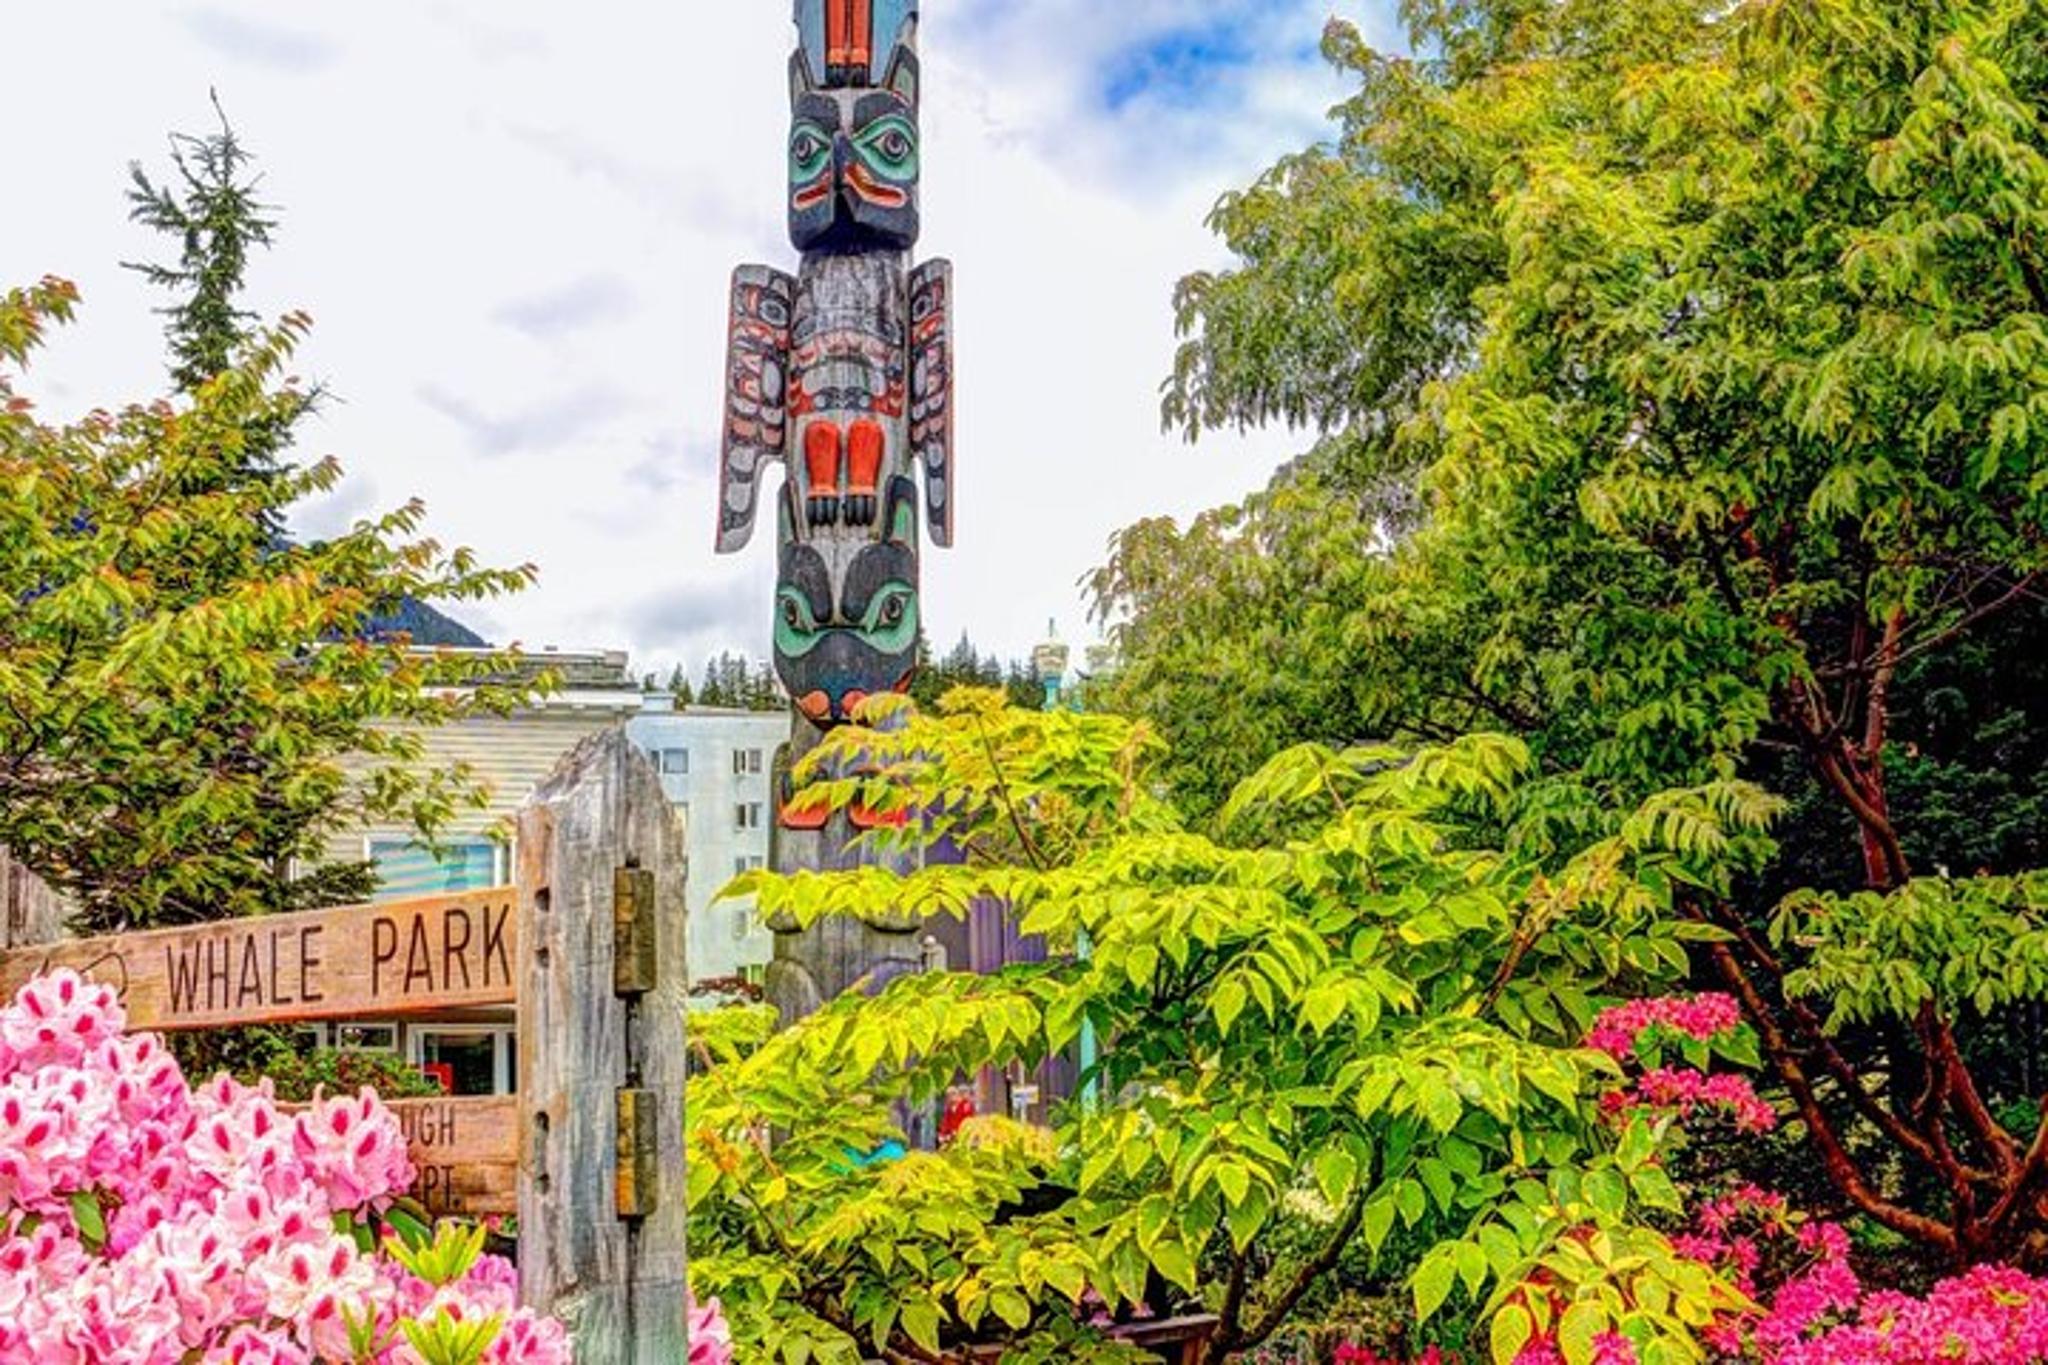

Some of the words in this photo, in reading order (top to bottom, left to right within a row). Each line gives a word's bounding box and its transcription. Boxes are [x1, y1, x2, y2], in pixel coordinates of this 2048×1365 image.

[165, 925, 325, 1014] WHALE
[370, 902, 513, 997] PARK
[410, 1165, 461, 1212] PT.
